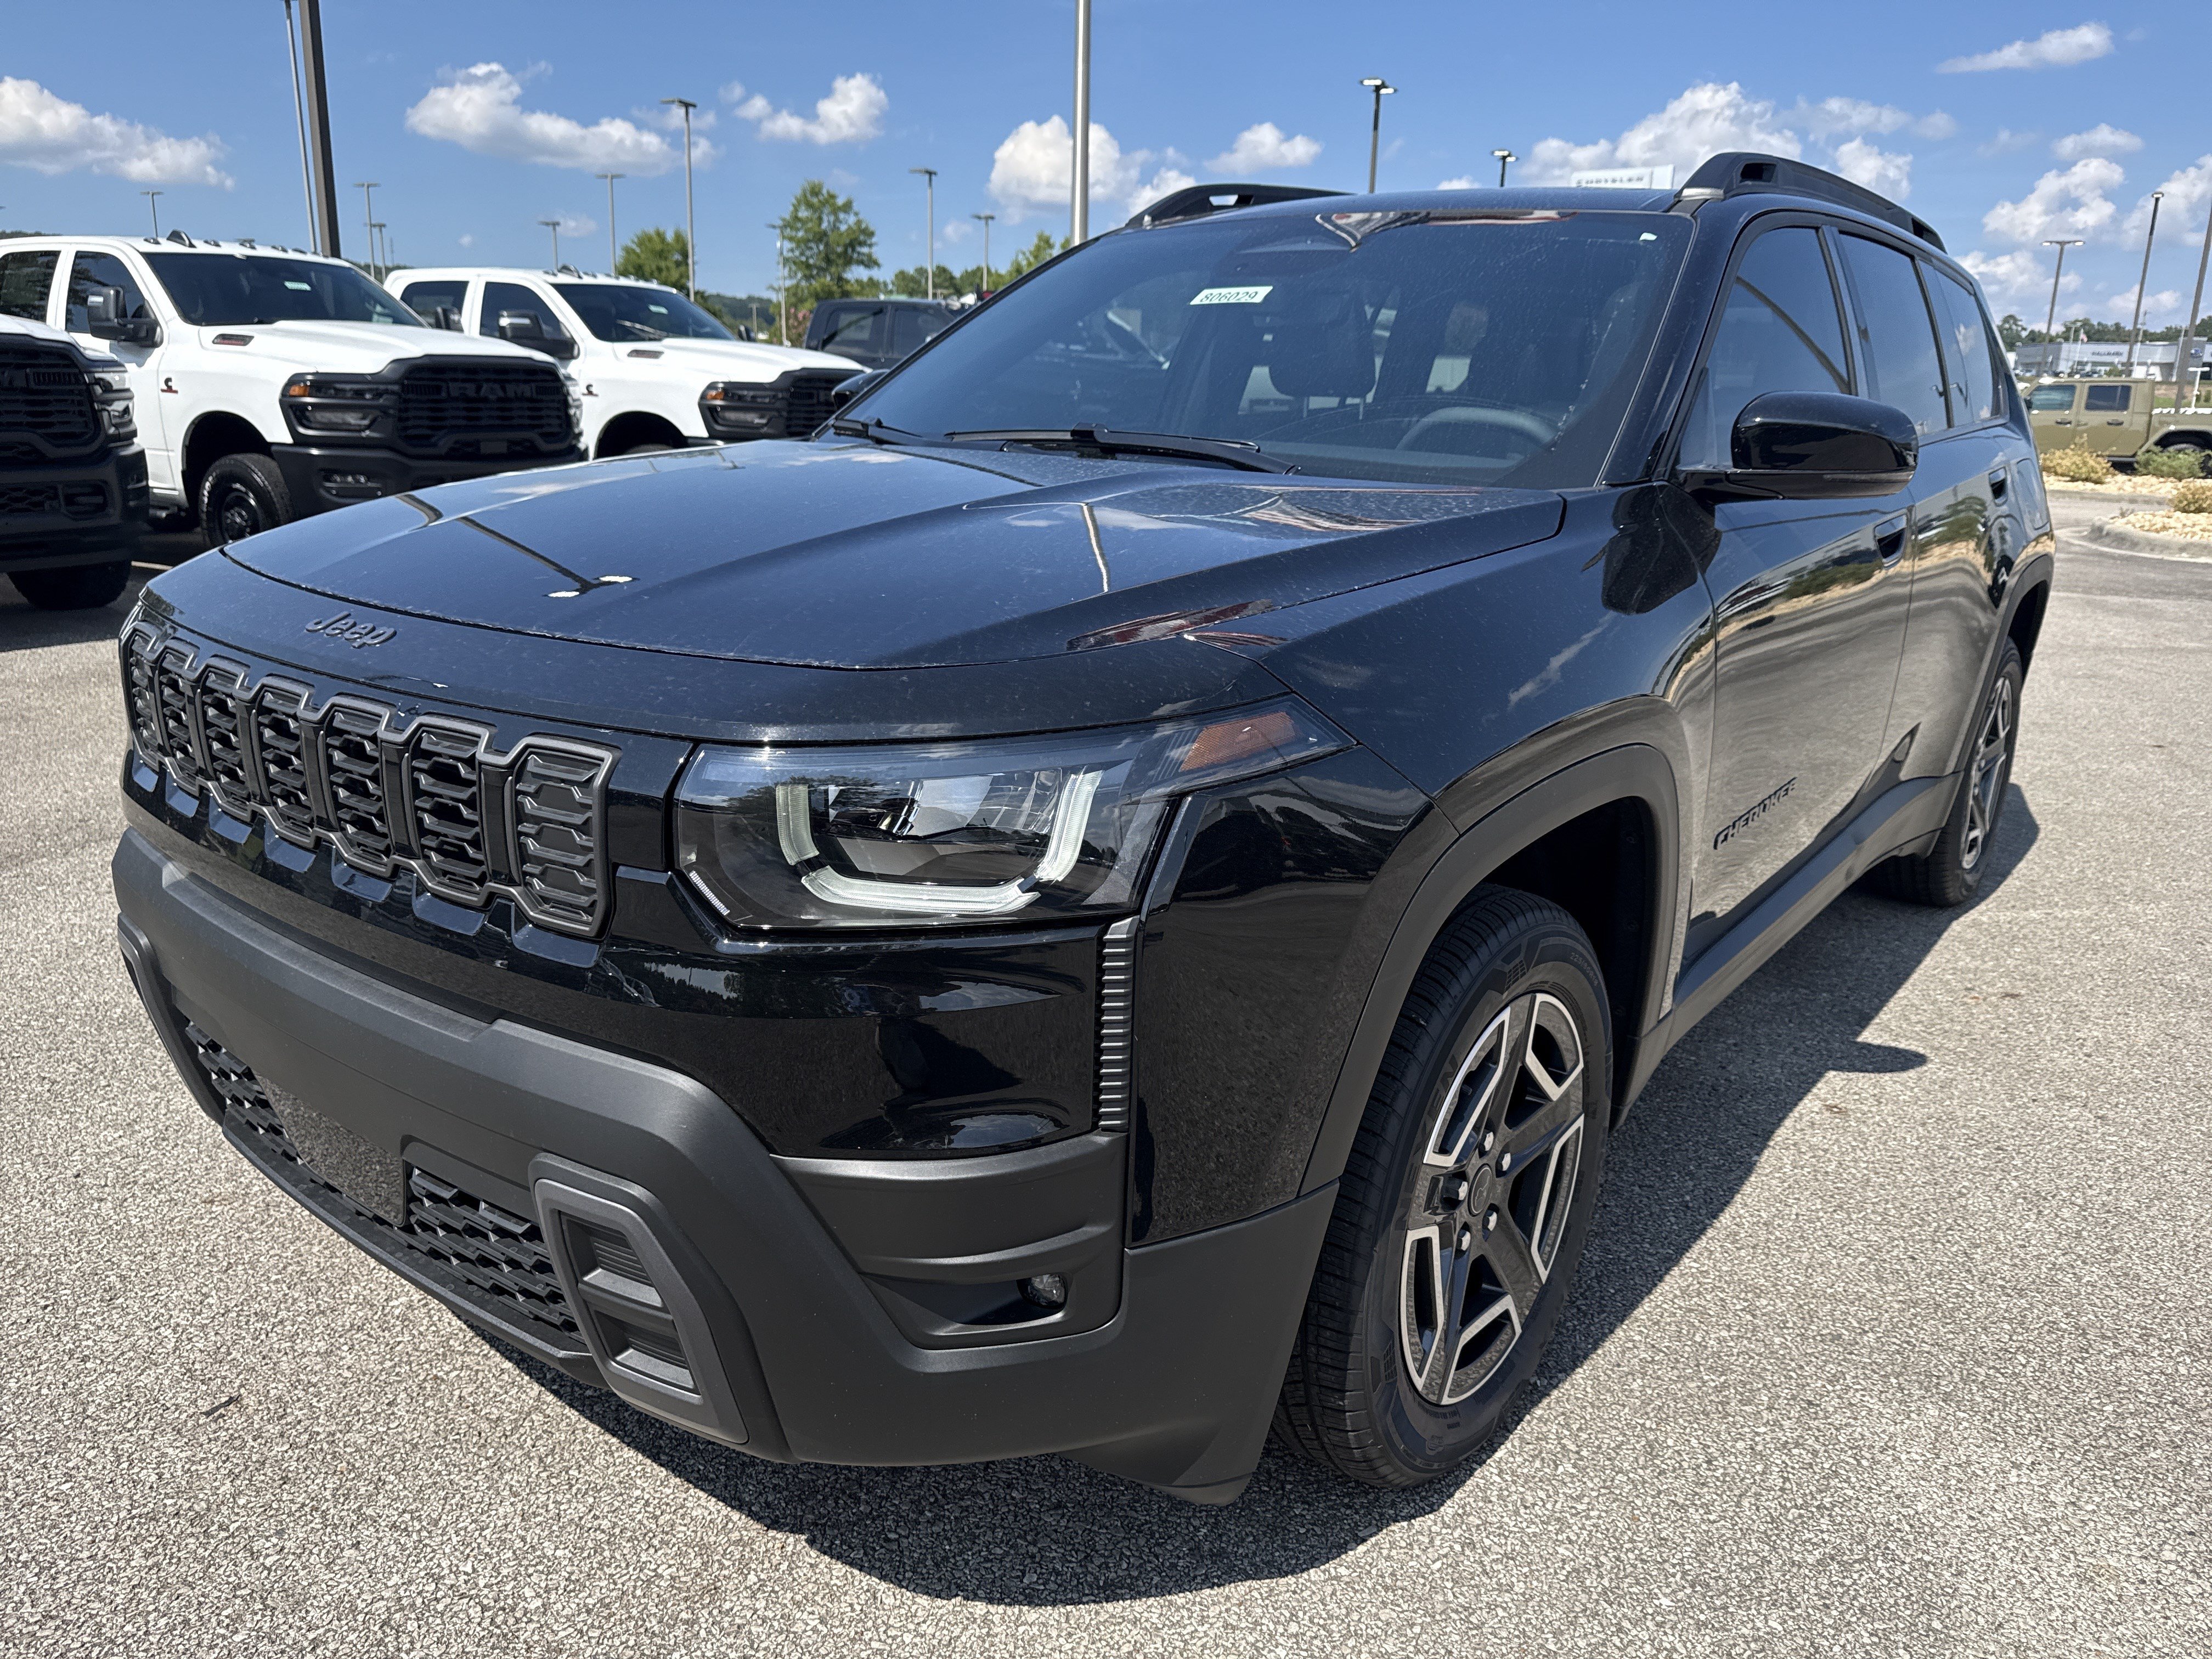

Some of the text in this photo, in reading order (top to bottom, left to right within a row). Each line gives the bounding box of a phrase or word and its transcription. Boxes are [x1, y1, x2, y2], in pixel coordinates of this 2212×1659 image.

[1199, 291, 1259, 303] 806029
[449, 382, 531, 399] RAM
[305, 611, 397, 649] Jeep
[1713, 776, 1797, 850] CHEROKEE
[1393, 1053, 1459, 1232] NEXEN
